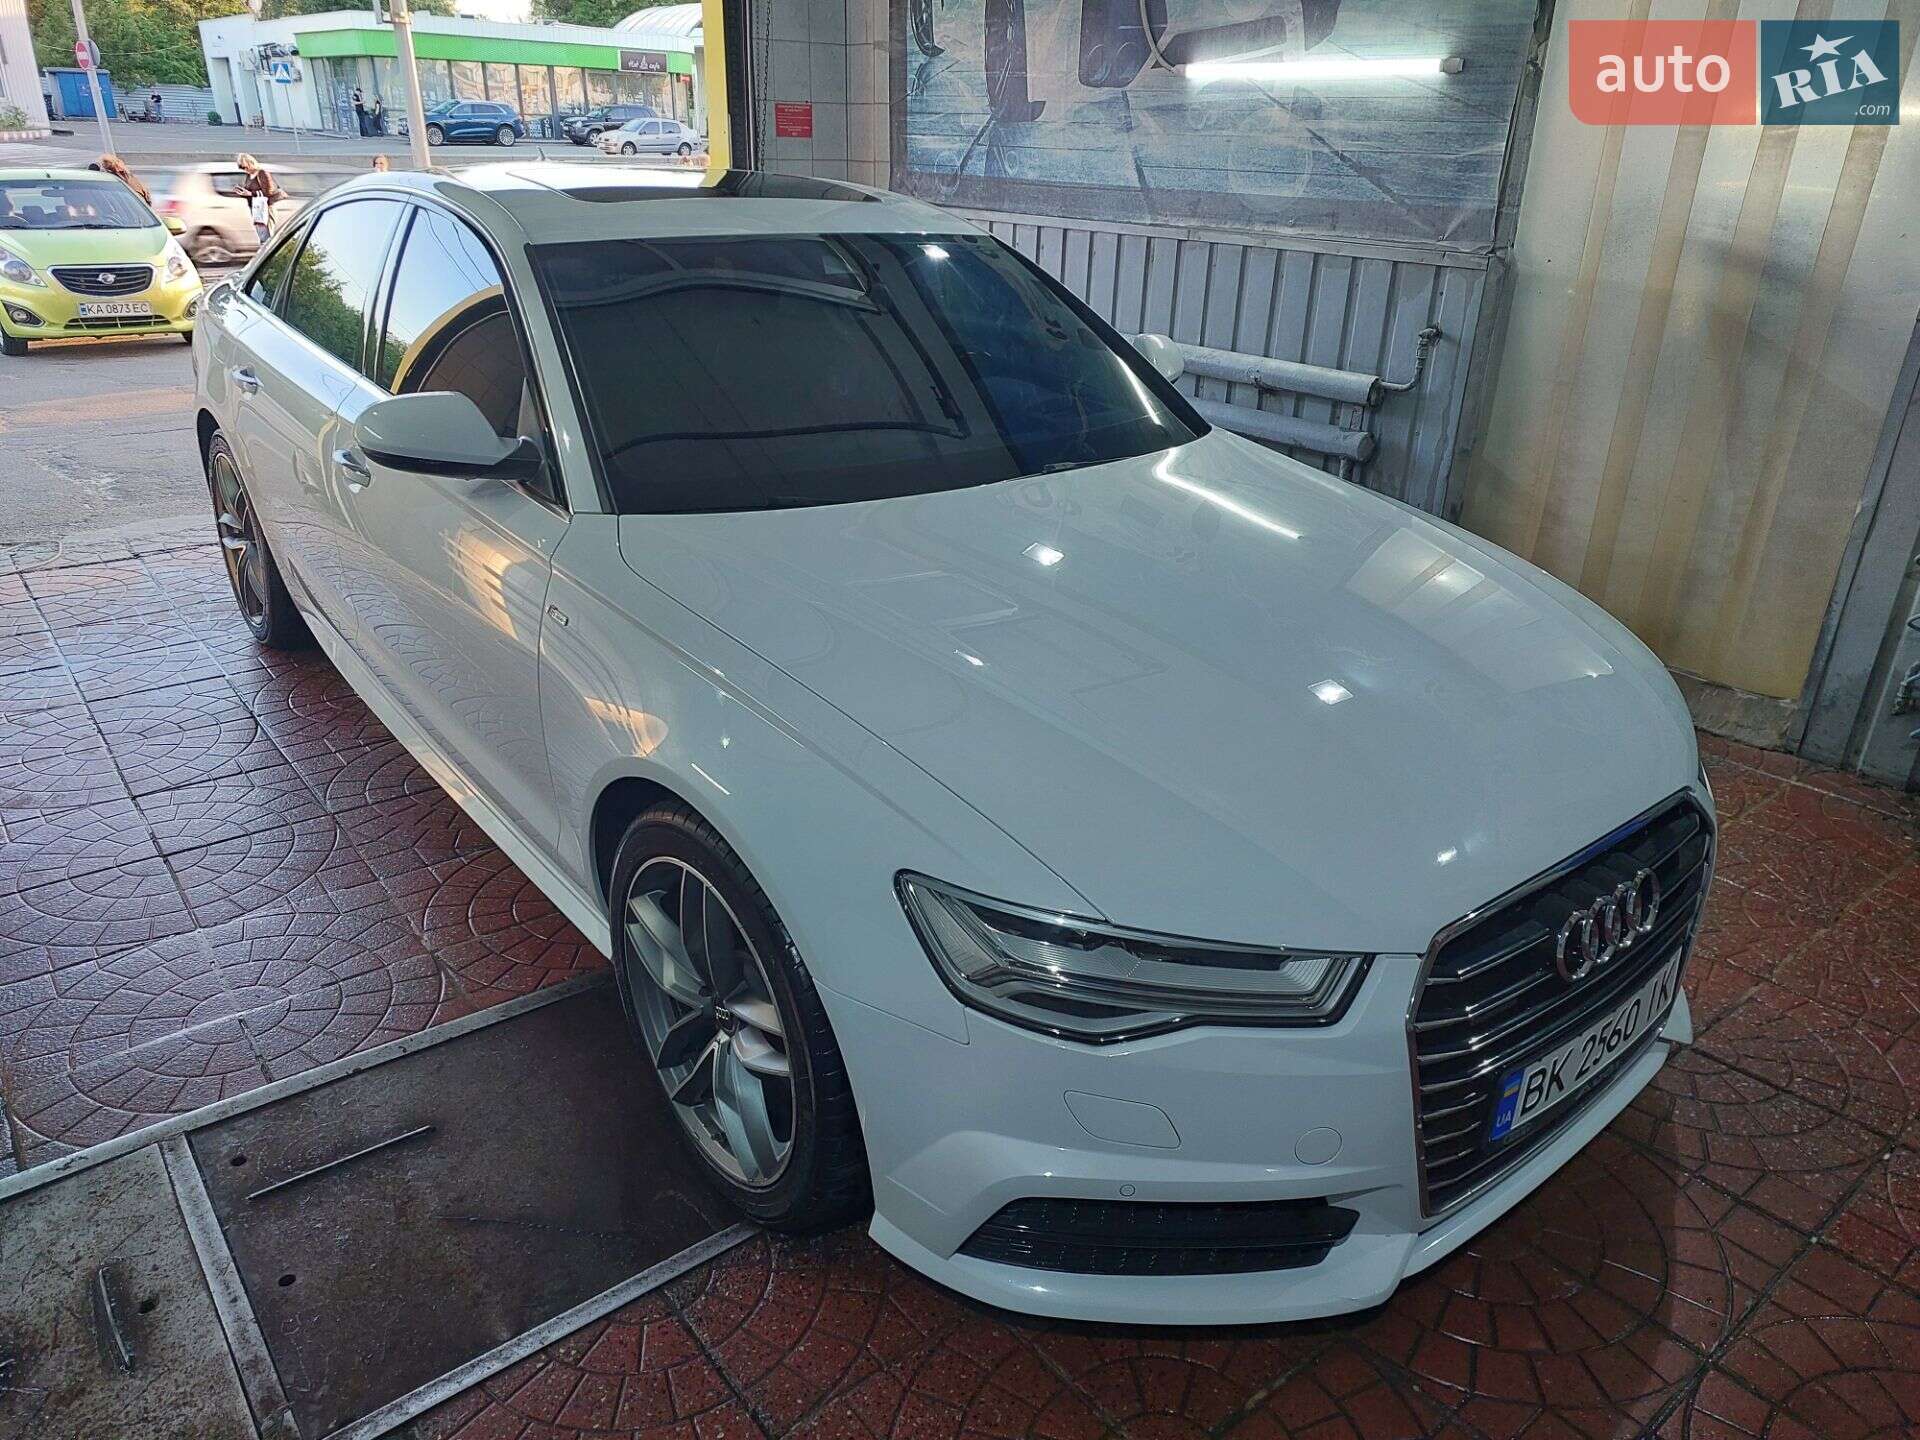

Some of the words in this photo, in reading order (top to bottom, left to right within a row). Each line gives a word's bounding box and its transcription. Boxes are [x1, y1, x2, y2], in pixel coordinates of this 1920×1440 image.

[87, 304, 104, 315] KA
[106, 303, 131, 314] 0873
[132, 303, 149, 313] EC
[1520, 1047, 1574, 1117] BK
[1575, 998, 1642, 1082] 2560
[1647, 959, 1677, 1022] IK
[1495, 1112, 1512, 1128] UA
